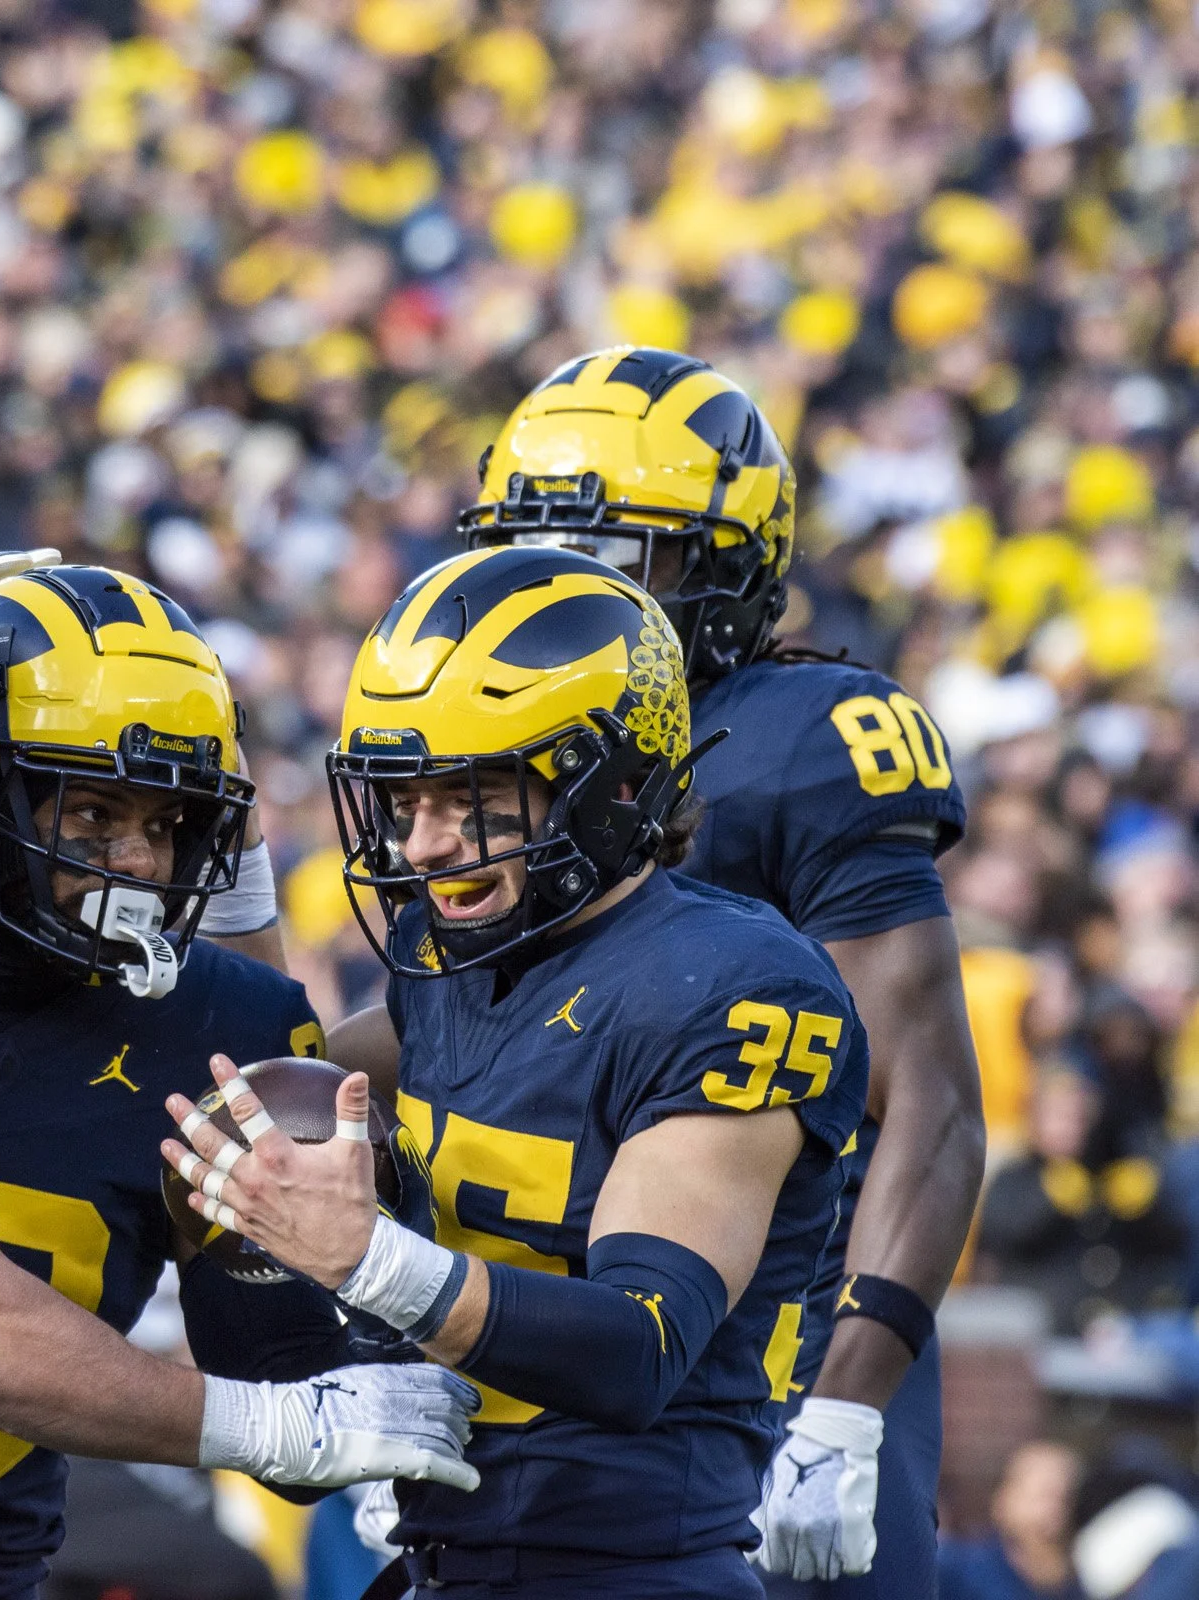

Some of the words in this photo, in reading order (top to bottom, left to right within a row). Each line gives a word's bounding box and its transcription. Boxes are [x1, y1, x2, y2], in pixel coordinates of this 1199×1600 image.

[150, 735, 194, 754] MICHIGAN
[361, 732, 403, 745] MICHIGAN
[829, 691, 952, 797] 80
[701, 1000, 843, 1112] 35
